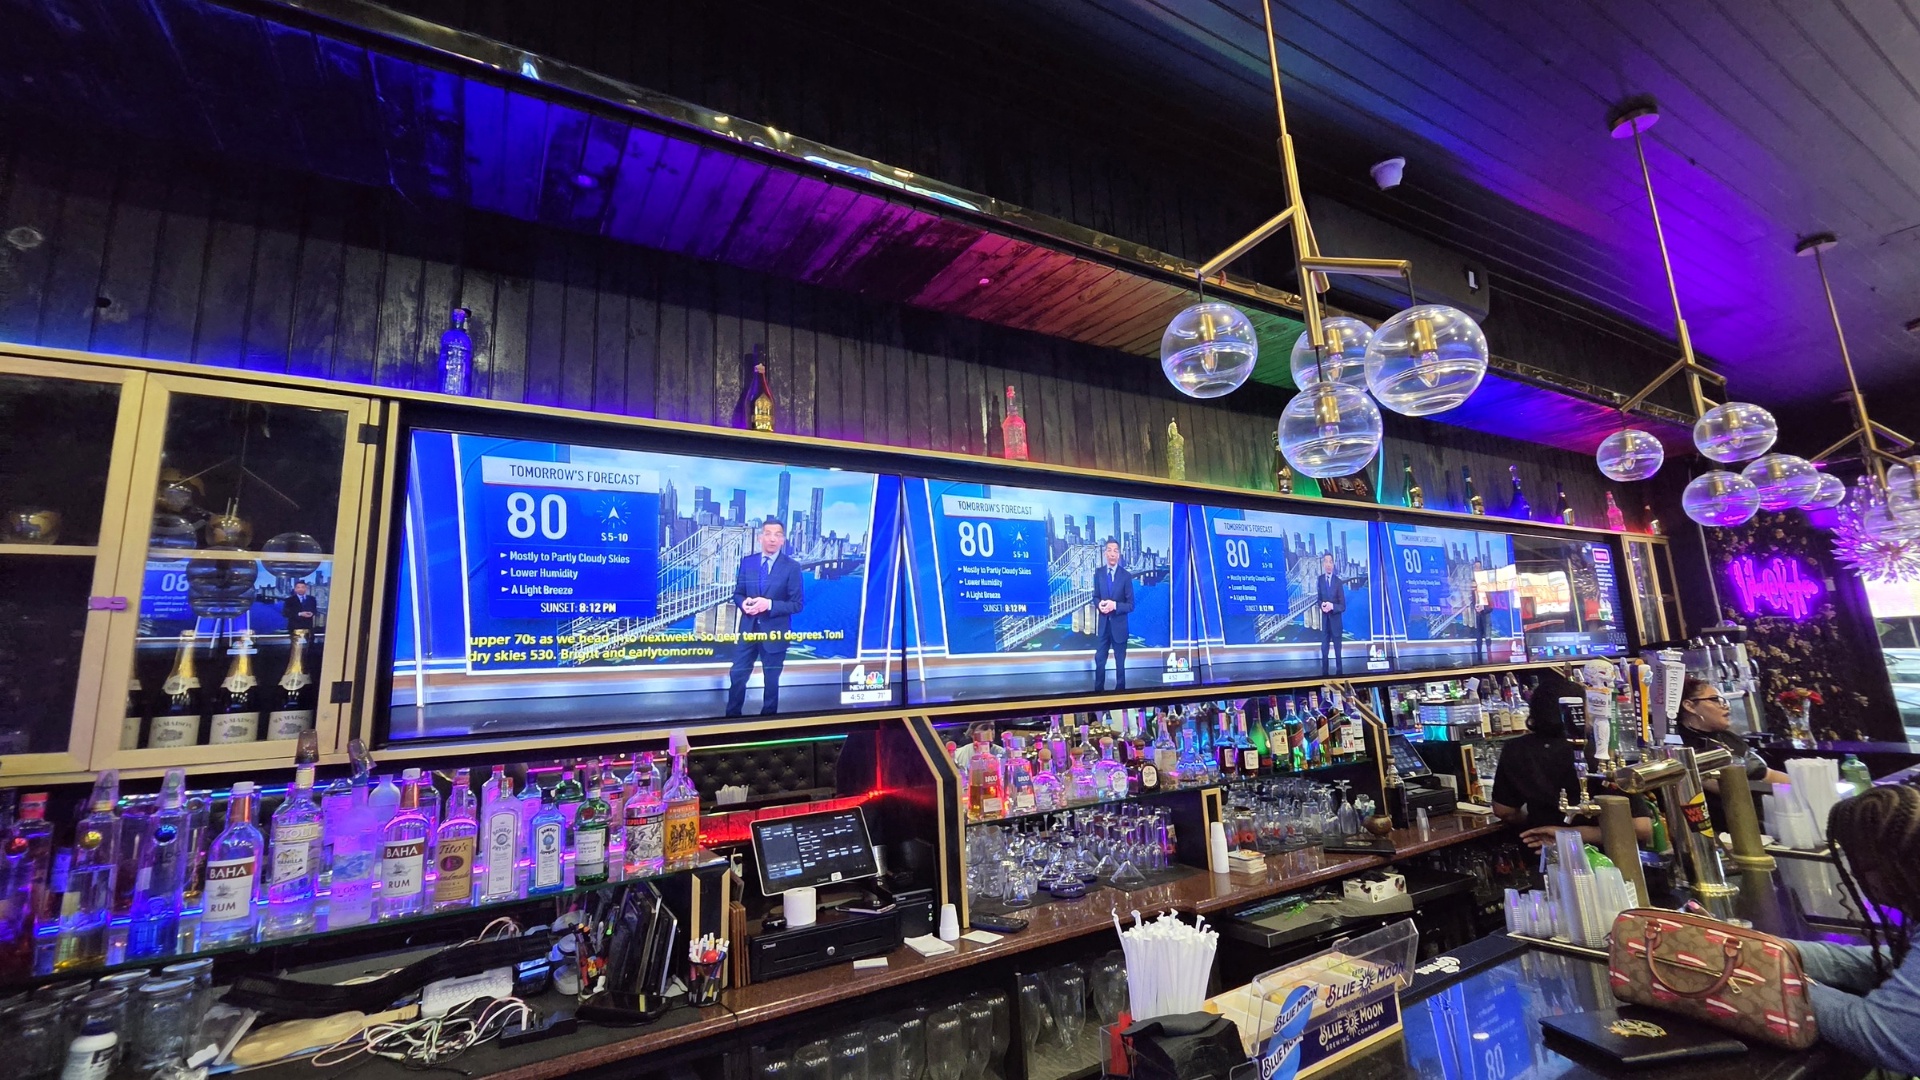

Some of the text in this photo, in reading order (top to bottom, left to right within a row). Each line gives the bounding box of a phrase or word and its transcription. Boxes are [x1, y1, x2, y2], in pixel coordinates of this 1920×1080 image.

[509, 464, 641, 485] TOMORROW'S FORECAST
[506, 491, 567, 540] 80
[958, 500, 1032, 515] TOMORROW'S FORECAST
[601, 532, 628, 543] S 5-10
[958, 521, 994, 557] 80
[510, 551, 630, 565] Mostly to Partly Cloudy Skies
[1225, 538, 1250, 568] 80
[1403, 548, 1422, 574] 80
[510, 568, 578, 580] Lower Humidity
[511, 585, 573, 597] A Light Breeze
[540, 602, 617, 613] SUNSET: 8:12 PM
[469, 635, 511, 648] upper
[514, 633, 536, 645] 70s
[539, 635, 554, 645] as
[556, 635, 575, 644] we
[578, 633, 609, 644] head
[701, 632, 713, 642] So
[716, 632, 740, 642] near
[743, 631, 767, 641] term
[769, 630, 782, 640] 61
[467, 650, 490, 664] dry
[494, 649, 527, 661] skies
[530, 649, 556, 661] 530.
[560, 648, 599, 662] Bright
[602, 648, 625, 659] and
[1166, 652, 1178, 668] 4
[849, 664, 866, 685] 4
[1668, 670, 1679, 712] PREMIER
[386, 845, 418, 858] BAHA
[439, 842, 469, 854] Tito's
[210, 865, 247, 879] BAHA
[388, 879, 410, 888] RUM
[210, 902, 236, 912] RUM
[1325, 961, 1405, 1008] BLUE MOON
[1273, 986, 1319, 1034] BLUE MOON
[1319, 1001, 1385, 1046] BLUE MOON
[1325, 1020, 1380, 1052] BREWING COMPANY
[1263, 1046, 1284, 1079] BLUE
